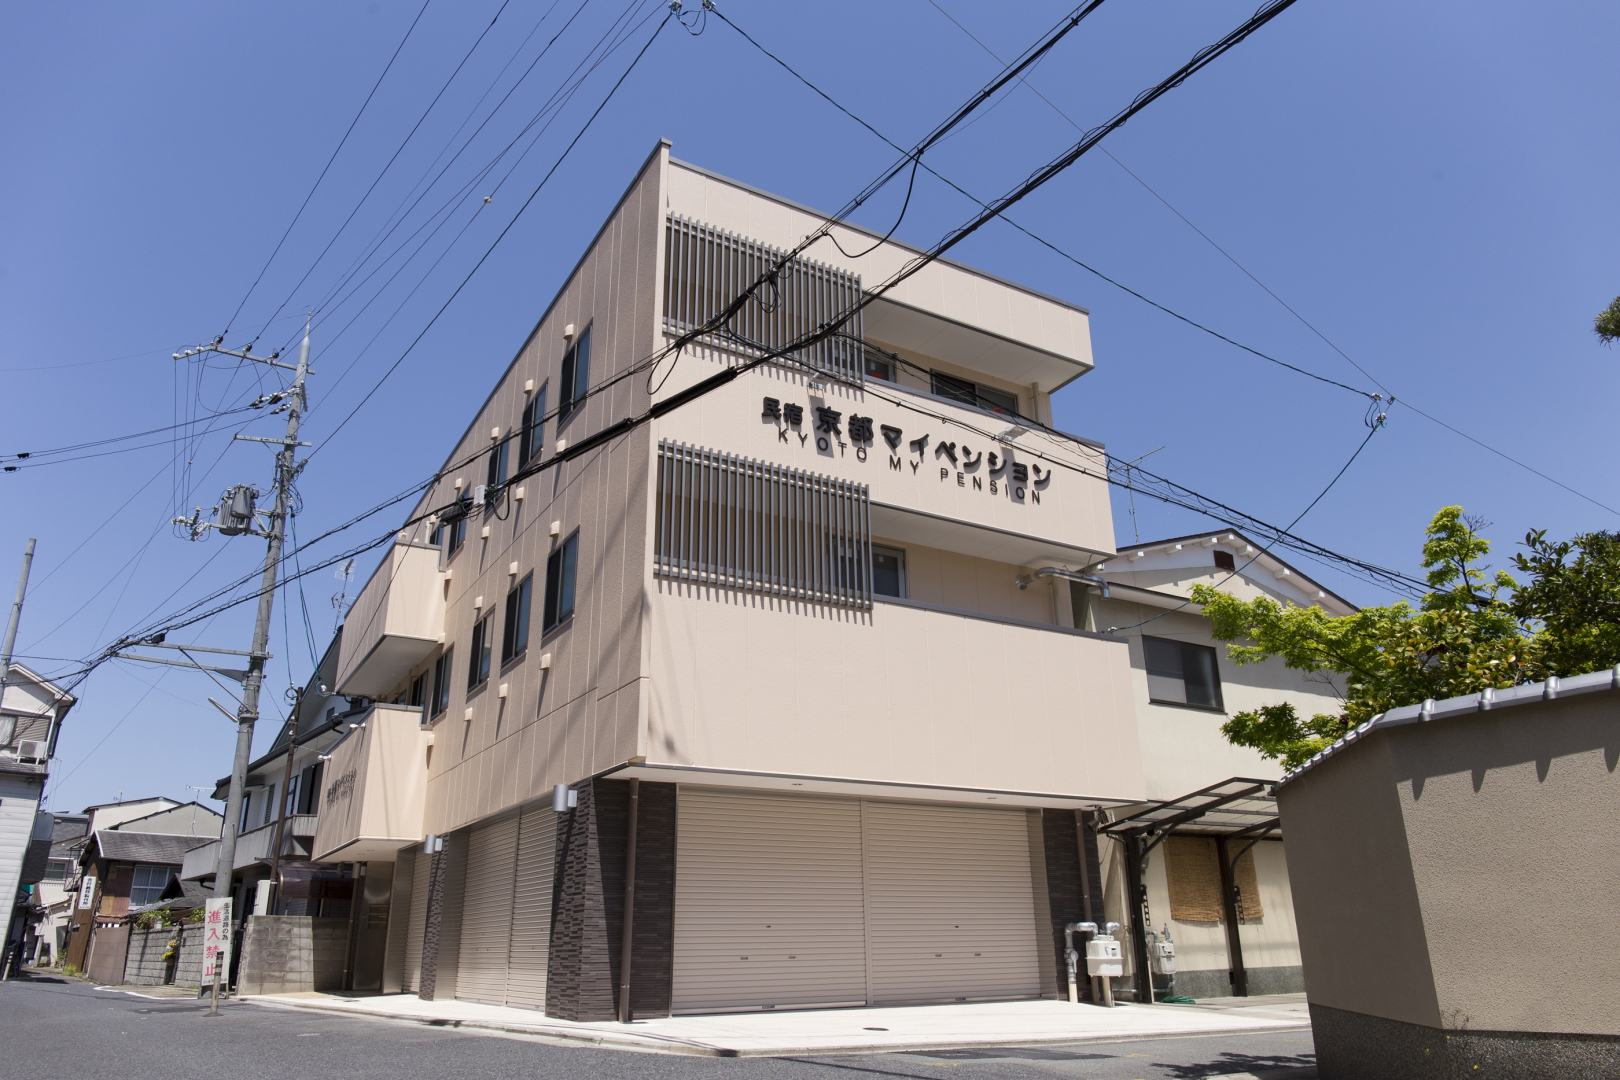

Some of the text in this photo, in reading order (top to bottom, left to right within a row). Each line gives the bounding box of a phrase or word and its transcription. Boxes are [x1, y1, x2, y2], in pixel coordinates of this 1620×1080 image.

[761, 396, 1051, 485] 民宿 京都マイペンション
[778, 427, 1041, 505] KYOTO MY PENSION
